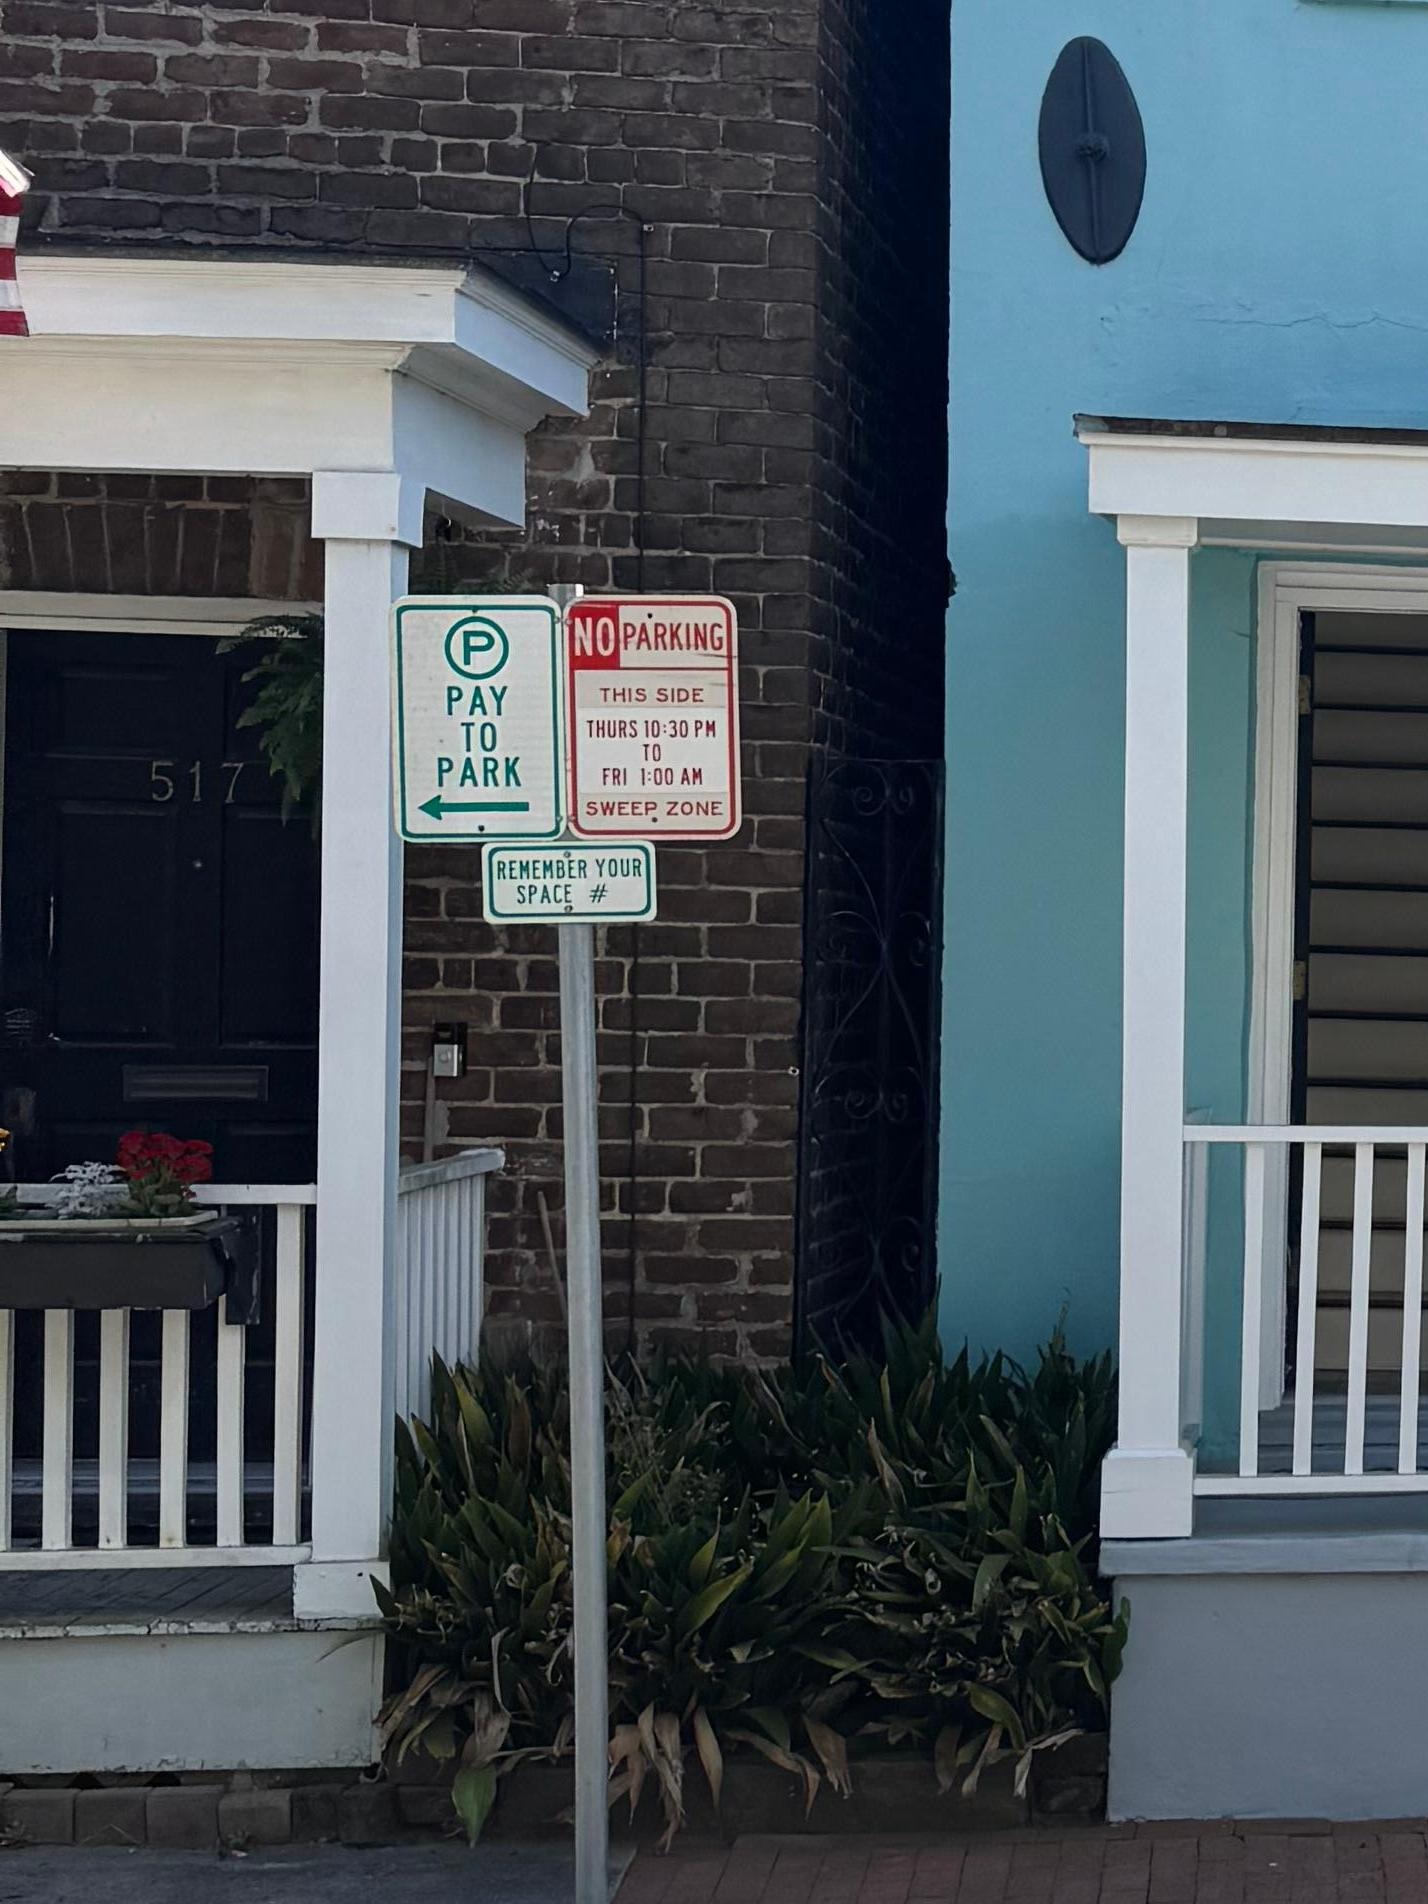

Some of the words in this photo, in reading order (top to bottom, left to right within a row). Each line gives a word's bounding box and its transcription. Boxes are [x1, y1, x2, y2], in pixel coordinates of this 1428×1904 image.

[462, 630, 496, 666] P
[574, 616, 616, 659] NO
[622, 622, 724, 652] PARKING
[446, 685, 508, 717] PAY
[599, 687, 648, 703] THIS
[656, 687, 705, 703] SIDE
[460, 721, 497, 754] TO
[586, 719, 638, 739] THURS
[643, 719, 689, 739] 10:30
[694, 720, 717, 739] PM
[642, 743, 662, 763] TO
[151, 760, 244, 803] 517
[437, 756, 522, 788] PARK
[602, 768, 628, 786] FRI
[640, 767, 674, 786] 1:00
[680, 767, 703, 786] AM
[585, 800, 658, 816] SWEEP
[666, 800, 724, 816] ZONE
[497, 859, 588, 880] REMEMBER
[595, 858, 642, 879] YOUR
[516, 883, 573, 905] SPACE
[588, 883, 608, 903] #
